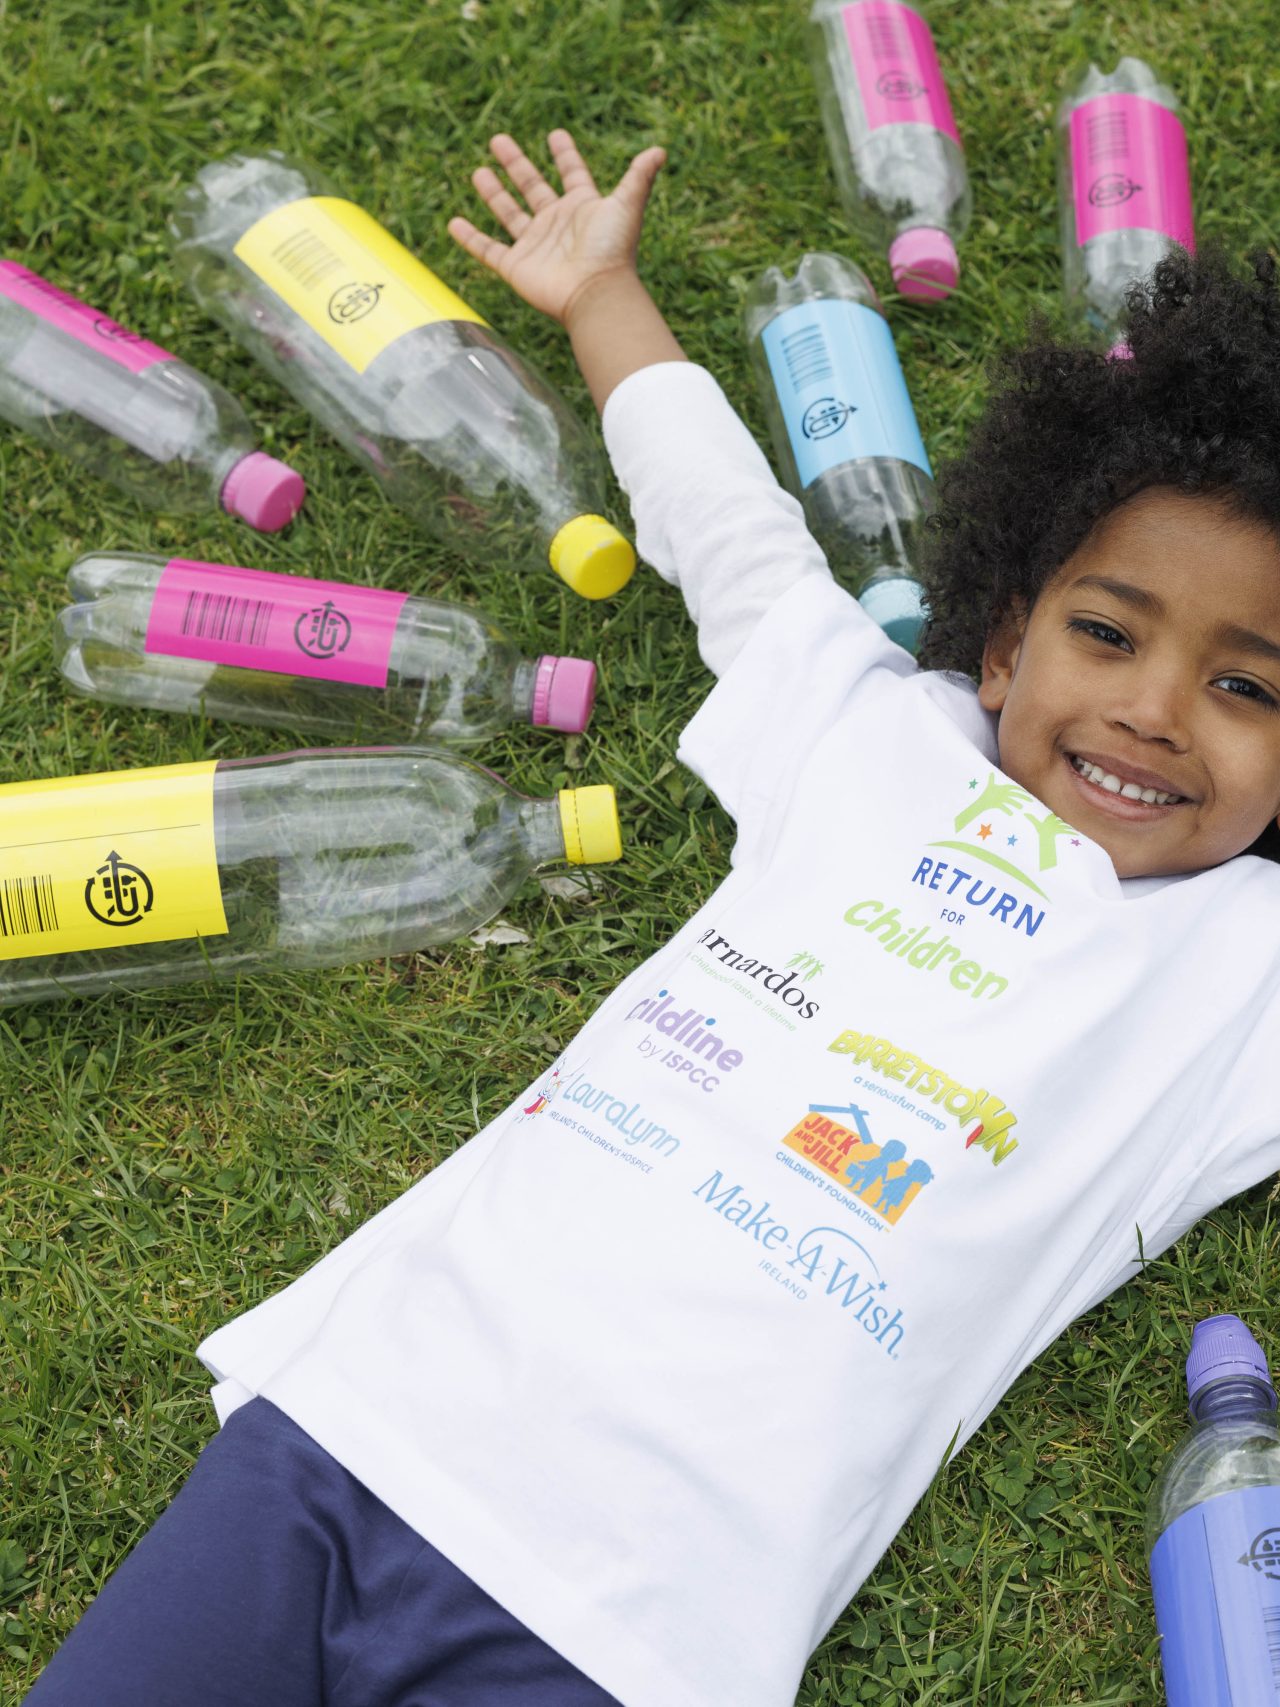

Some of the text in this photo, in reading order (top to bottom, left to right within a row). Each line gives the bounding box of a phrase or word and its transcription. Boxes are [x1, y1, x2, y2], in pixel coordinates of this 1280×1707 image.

[911, 856, 1046, 937] RETURN
[940, 908, 966, 926] FOR
[843, 900, 1009, 1000] Children
[637, 1034, 720, 1092] by ISPCC
[562, 1073, 681, 1158] LauraLynn
[826, 1029, 1019, 1167] BARRETSTOWN
[853, 1076, 863, 1084] a
[916, 1109, 947, 1131] camp
[577, 1125, 621, 1156] CHILDREN'S
[620, 1151, 654, 1174] HOSPICE
[794, 1129, 815, 1143] AND
[803, 1140, 843, 1174] JILL
[804, 1116, 861, 1156] JACK
[775, 1151, 884, 1231] CHILDREN'S FOUNDATION
[758, 1259, 808, 1300] IRELAND
